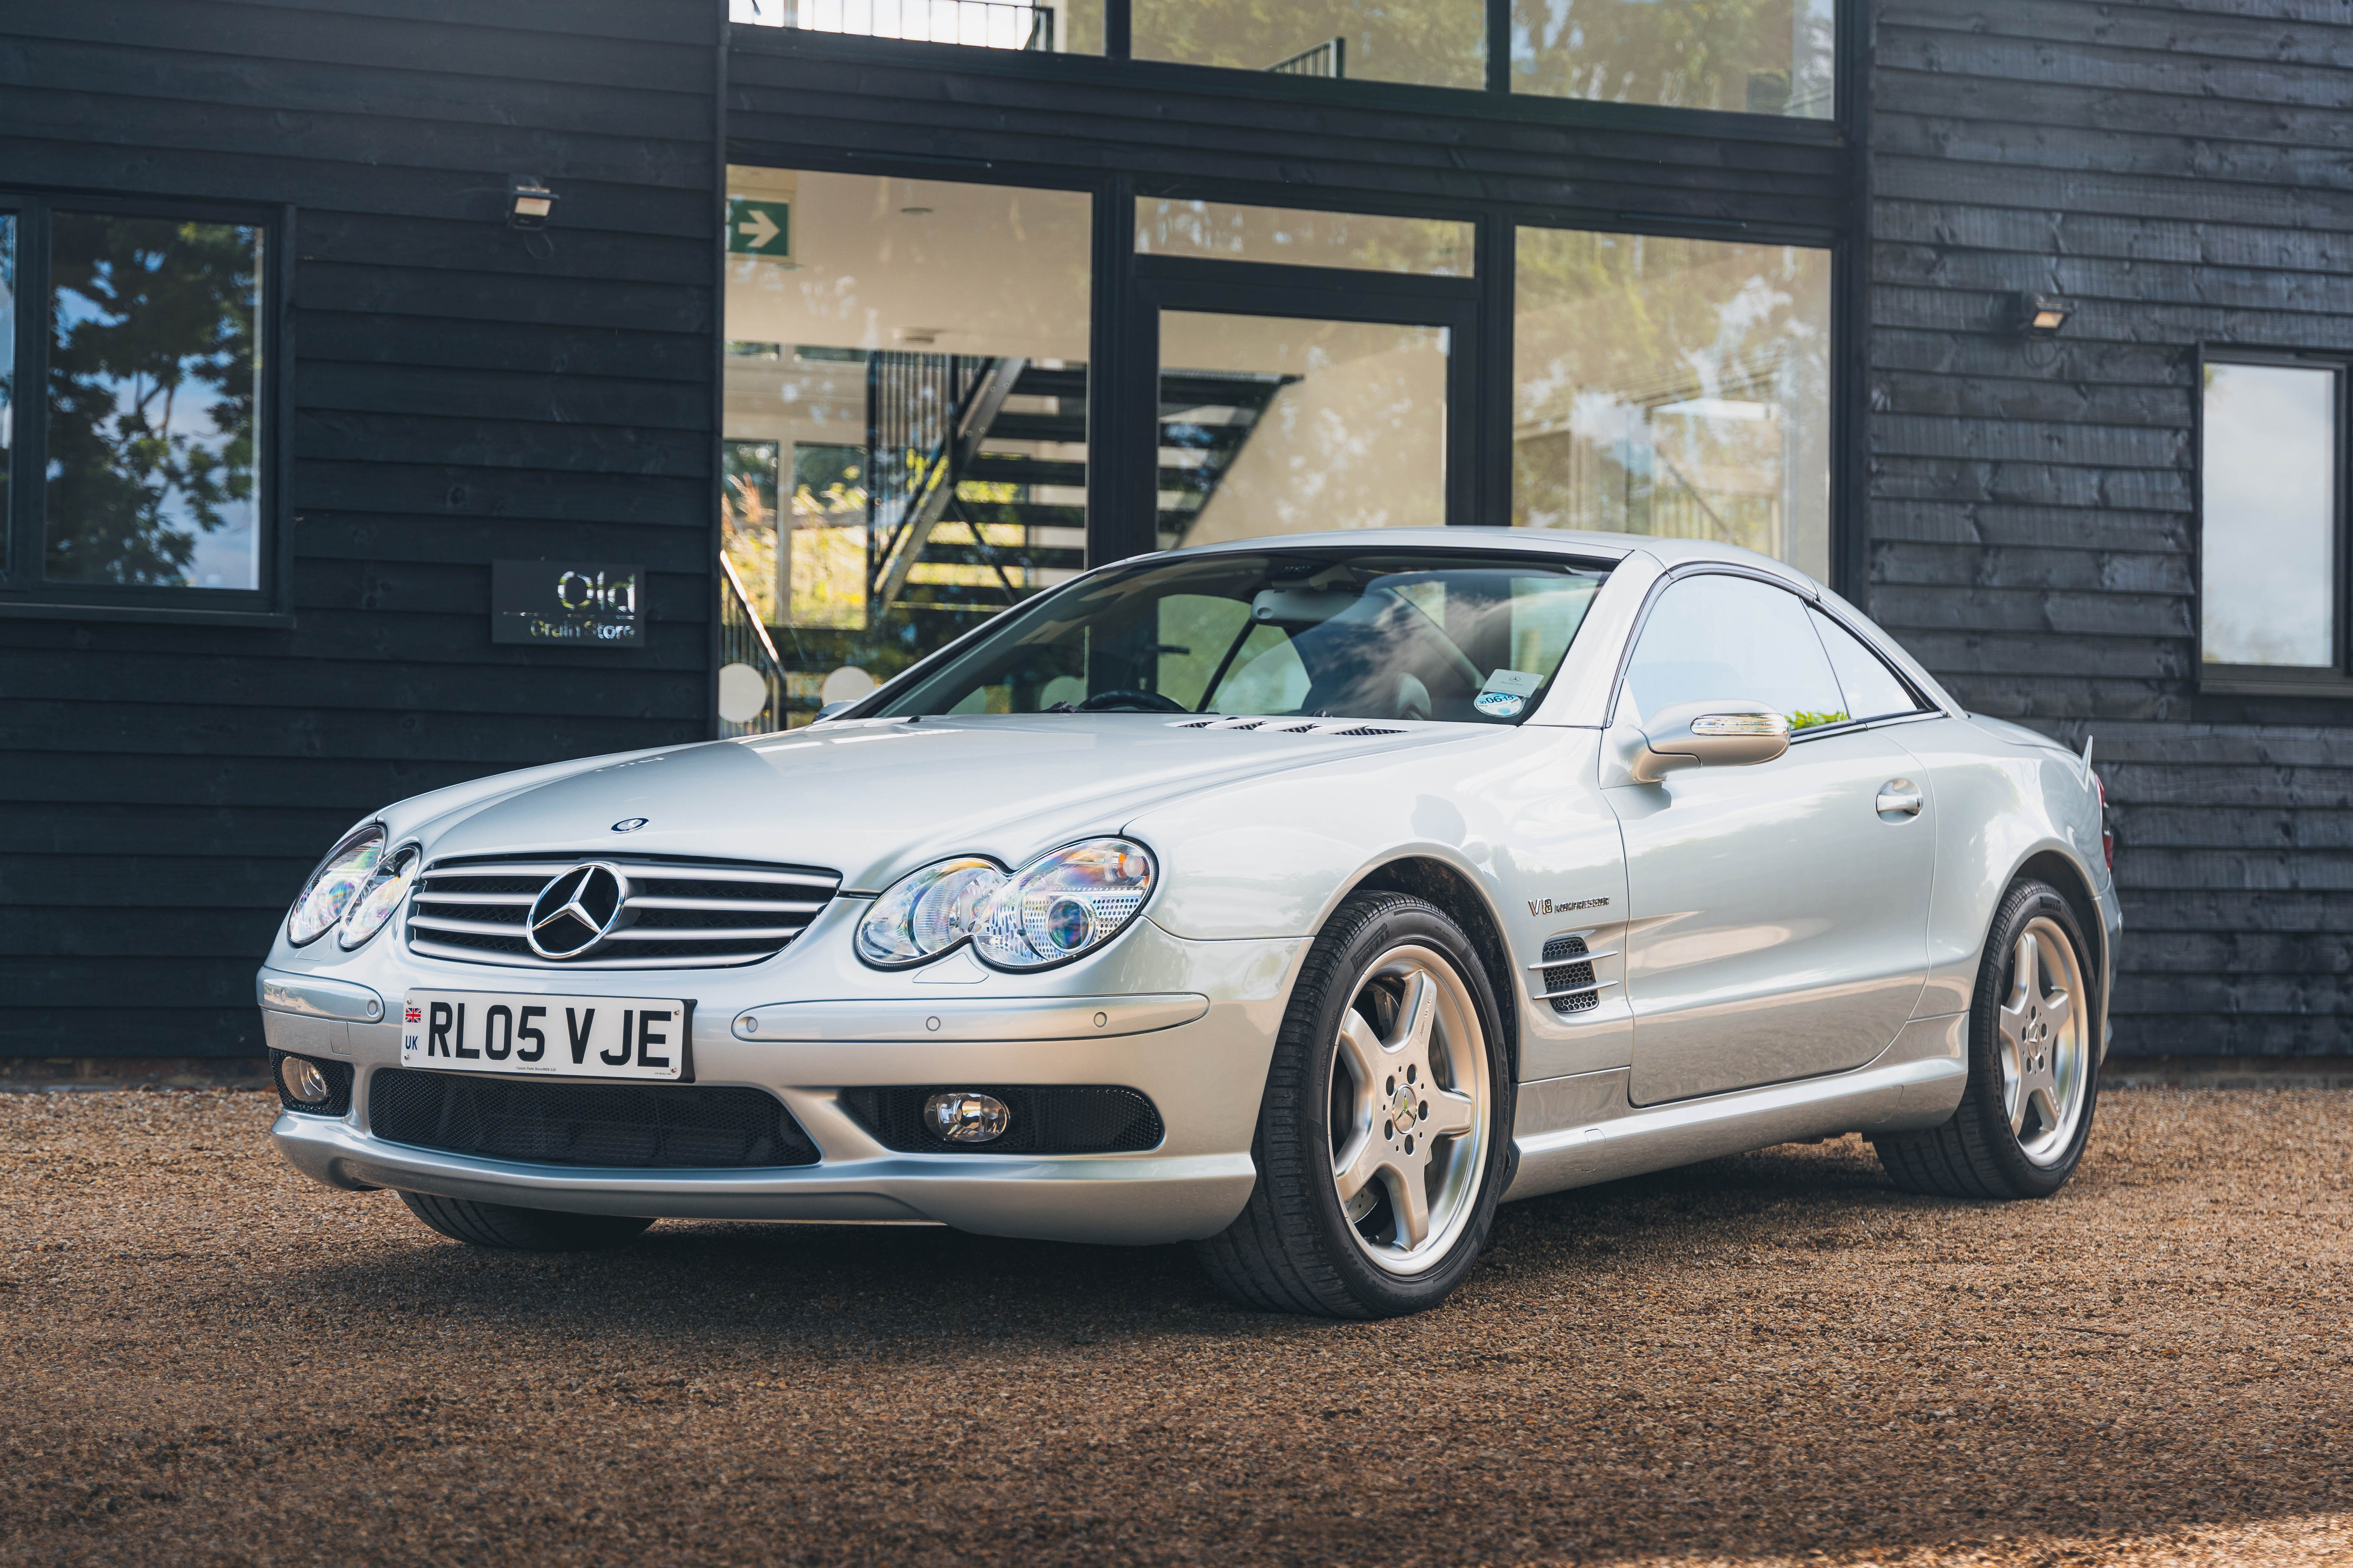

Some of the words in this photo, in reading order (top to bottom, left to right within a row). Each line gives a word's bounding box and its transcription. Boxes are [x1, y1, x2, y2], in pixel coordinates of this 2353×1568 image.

[557, 571, 636, 613] Old
[530, 619, 581, 638] Grain
[584, 620, 636, 640] Store
[1528, 897, 1552, 916] V8
[1554, 896, 1610, 913] KOMPRESSOR
[405, 1035, 418, 1051] UK
[428, 1001, 547, 1062] RL05
[565, 1007, 672, 1068] VJE
